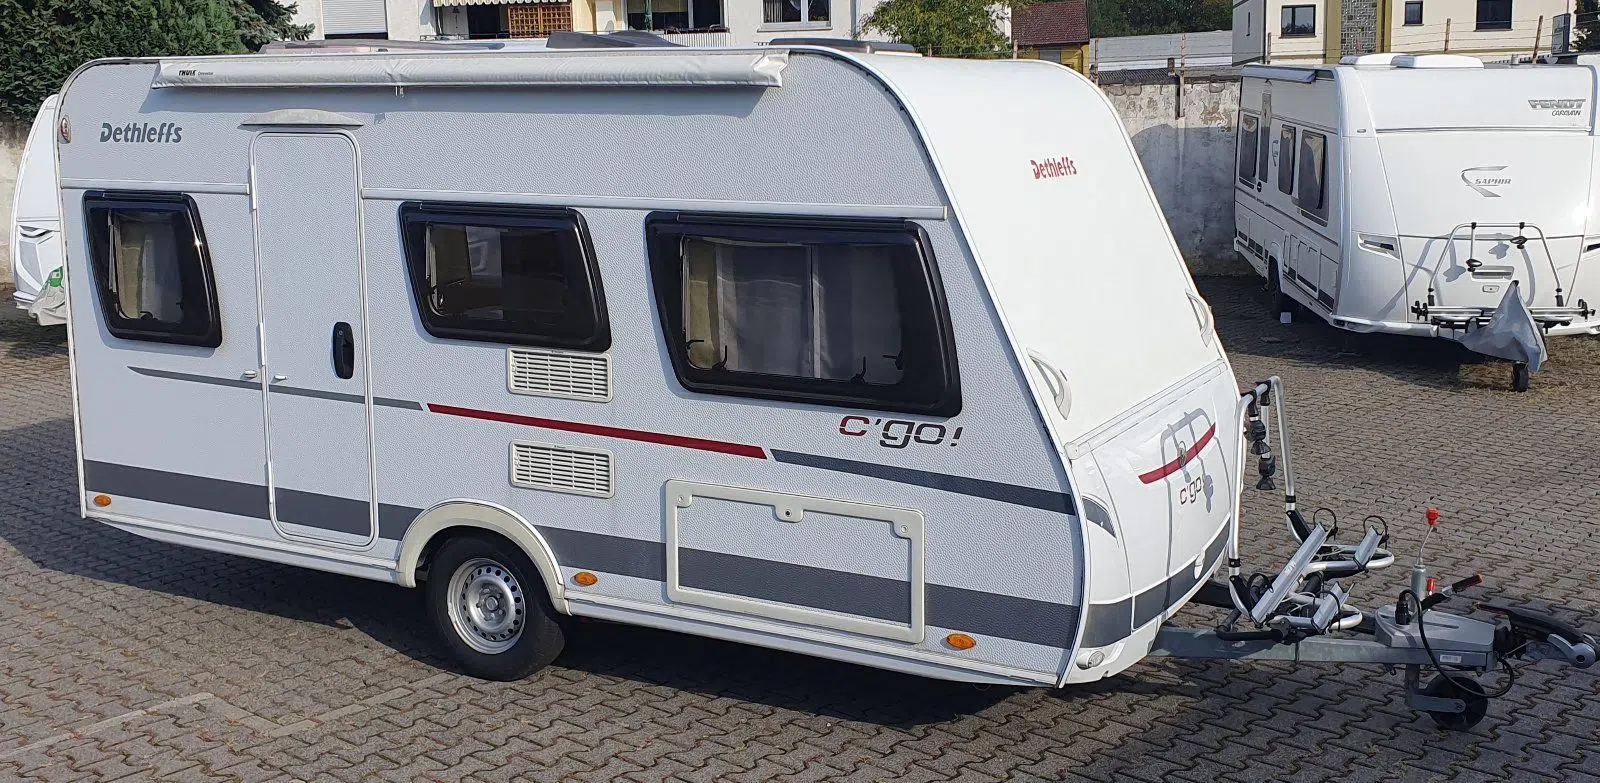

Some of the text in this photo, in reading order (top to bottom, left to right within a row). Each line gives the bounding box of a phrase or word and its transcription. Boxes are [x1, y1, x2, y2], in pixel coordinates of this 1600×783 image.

[1528, 98, 1587, 109] FENDT
[100, 122, 183, 143] Dethleffs
[1030, 156, 1077, 179] Dethleffs
